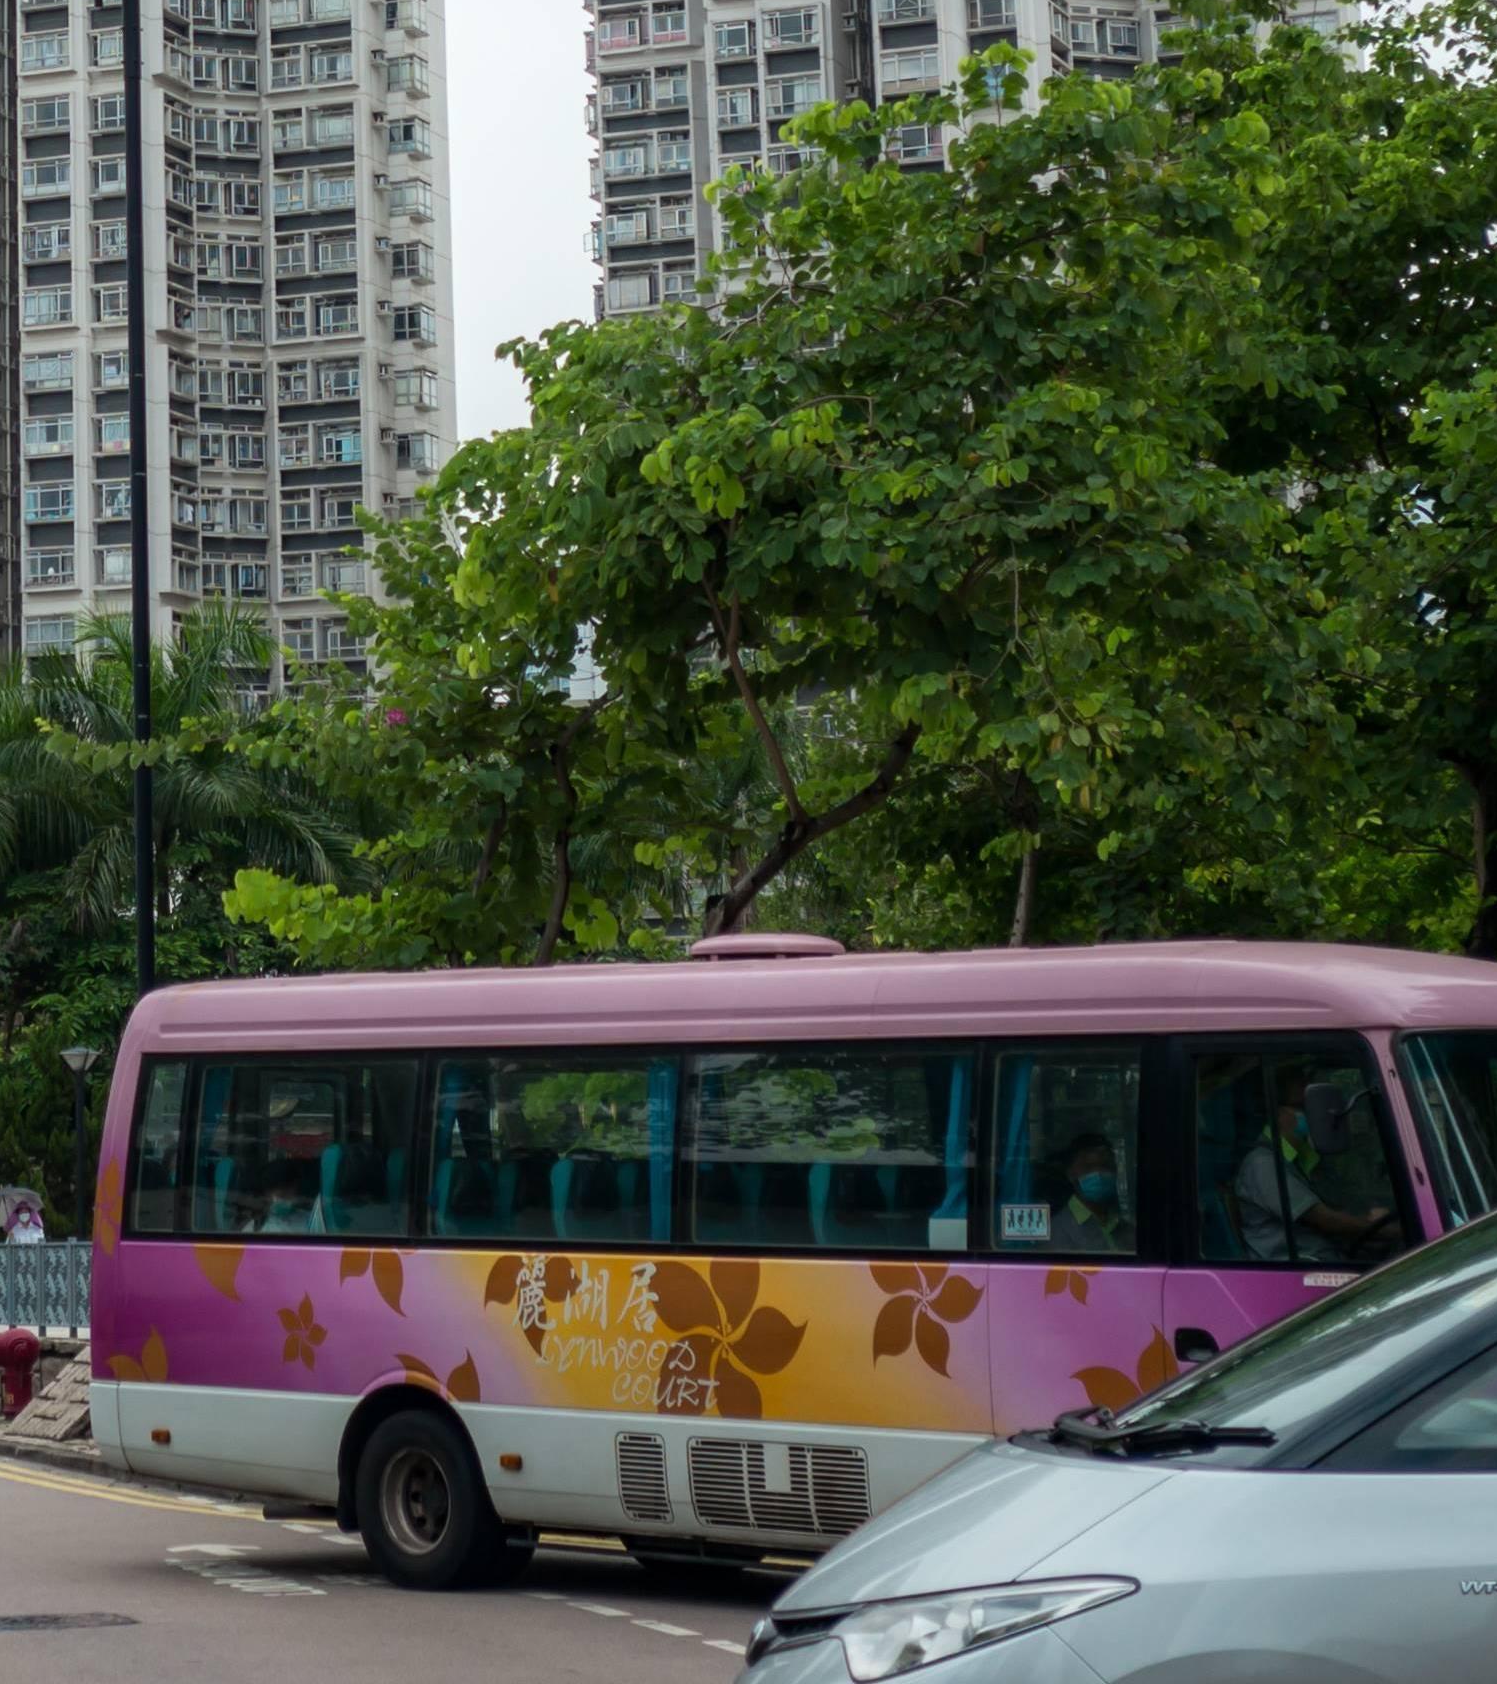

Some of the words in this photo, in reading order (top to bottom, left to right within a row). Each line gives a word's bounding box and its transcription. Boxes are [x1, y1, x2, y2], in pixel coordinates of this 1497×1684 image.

[512, 1254, 659, 1333] 麗湖居
[535, 1335, 696, 1373] LYNWOOD
[612, 1373, 720, 1408] COURT
